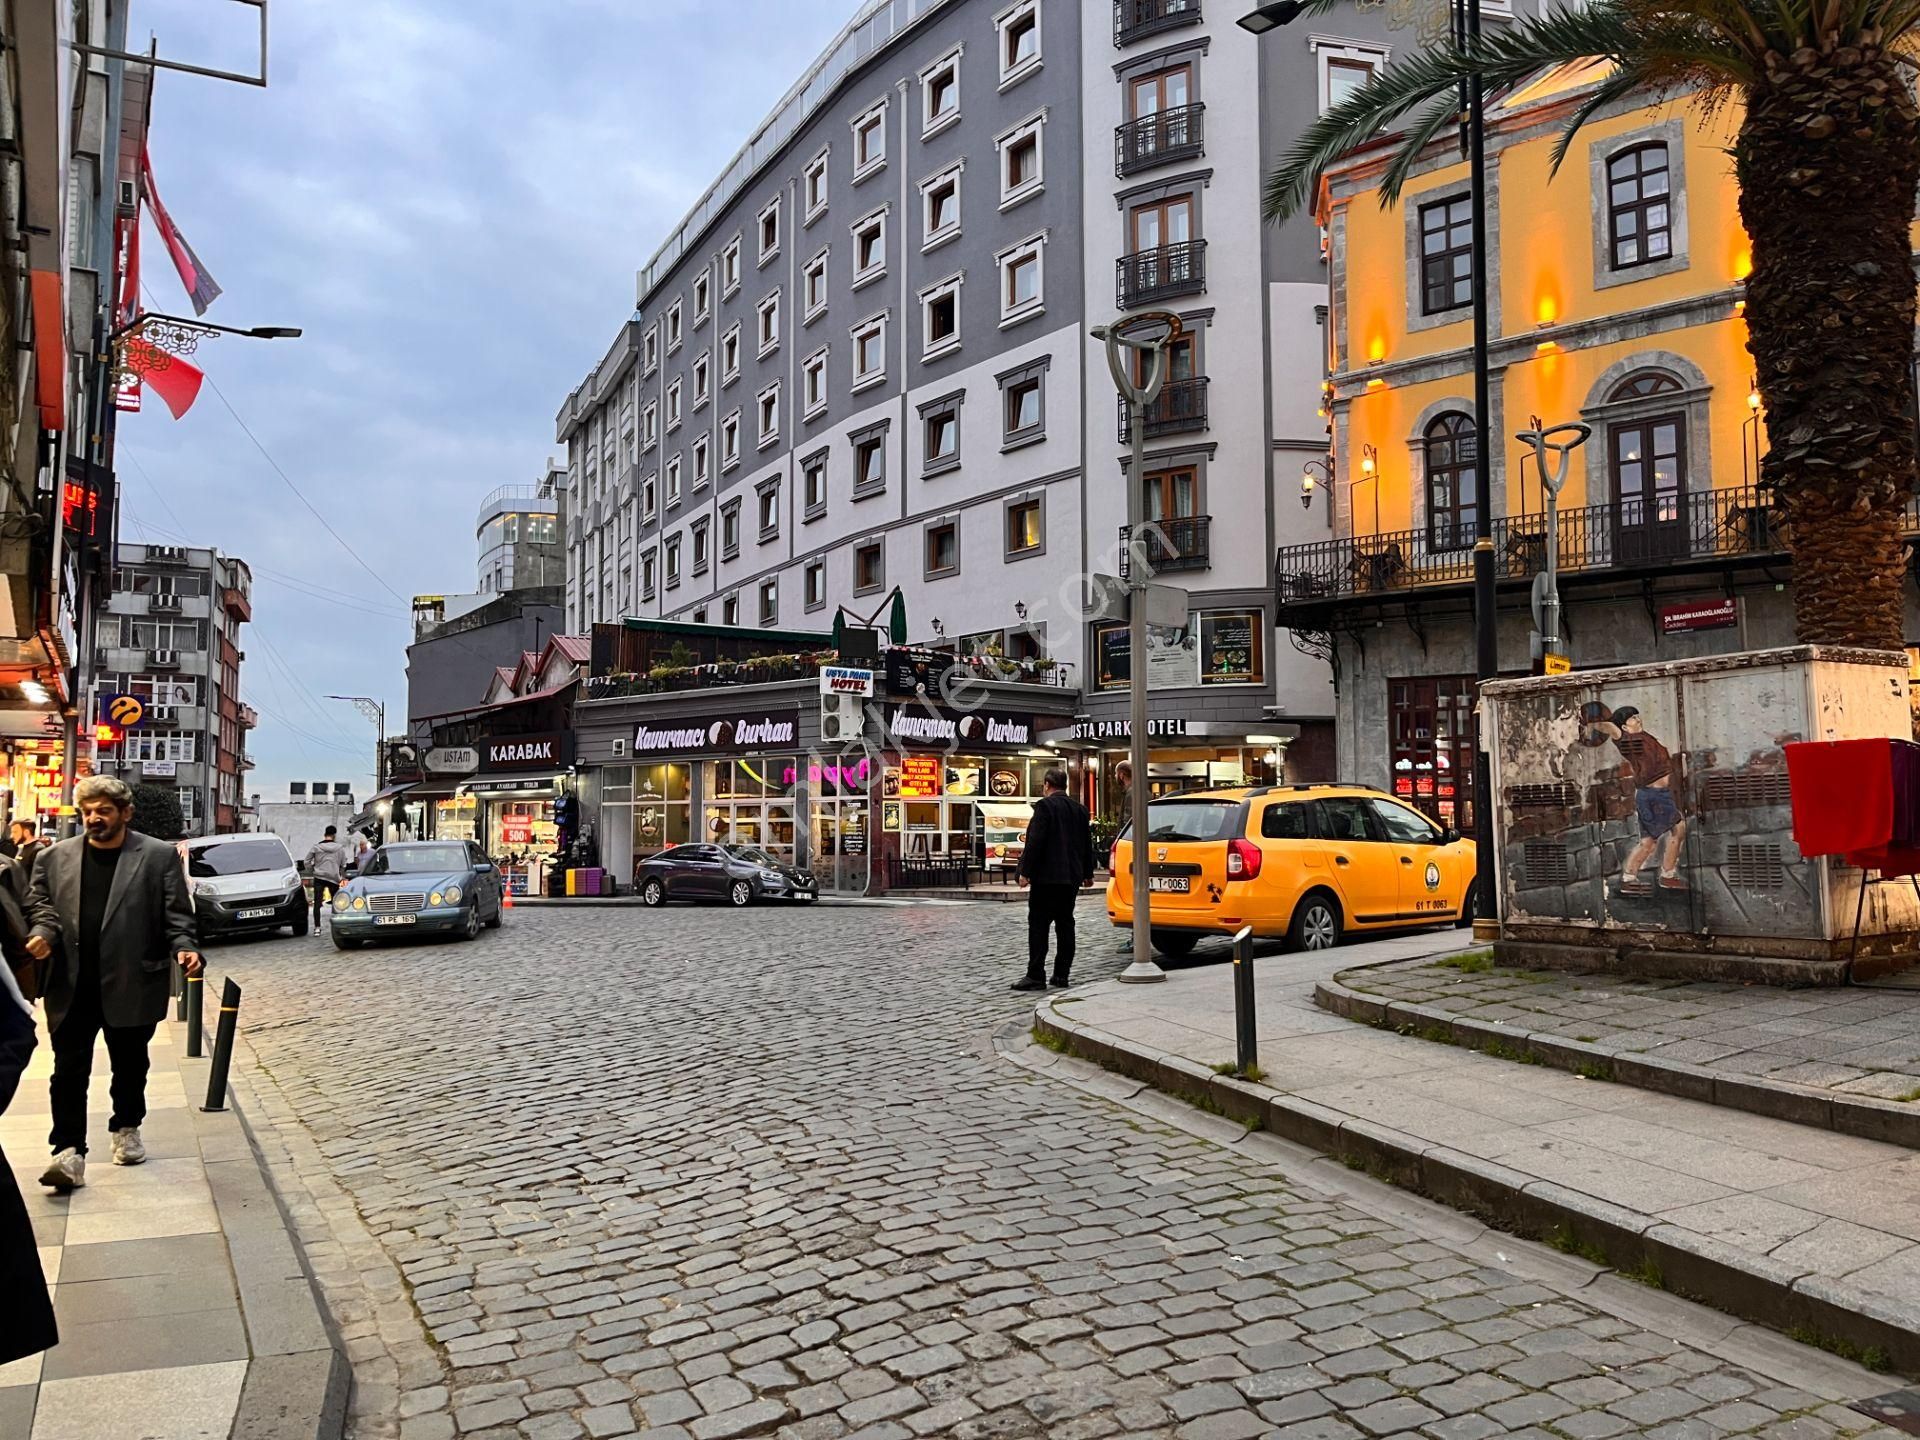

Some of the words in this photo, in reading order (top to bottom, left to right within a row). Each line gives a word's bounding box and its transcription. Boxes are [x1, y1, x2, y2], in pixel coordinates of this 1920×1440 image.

[825, 668, 848, 678] USTA
[849, 670, 871, 681] PARK
[830, 678, 867, 691] HOTEL
[634, 726, 706, 750] Kavurmacı
[734, 717, 794, 745] Burhan
[890, 710, 957, 739] Kavurmacı
[986, 717, 1029, 744] Burhan
[1070, 722, 1095, 739] USTA
[1098, 720, 1132, 737] PARK
[1147, 719, 1185, 736] OTEL
[490, 742, 552, 762] KARABAK
[1158, 878, 1163, 889] T
[1168, 878, 1188, 889] 0063
[1416, 901, 1424, 911] 61
[1426, 901, 1431, 909] T
[1433, 899, 1448, 909] 0063
[377, 916, 386, 924] 61
[389, 916, 399, 924] PE
[402, 915, 415, 923] 169
